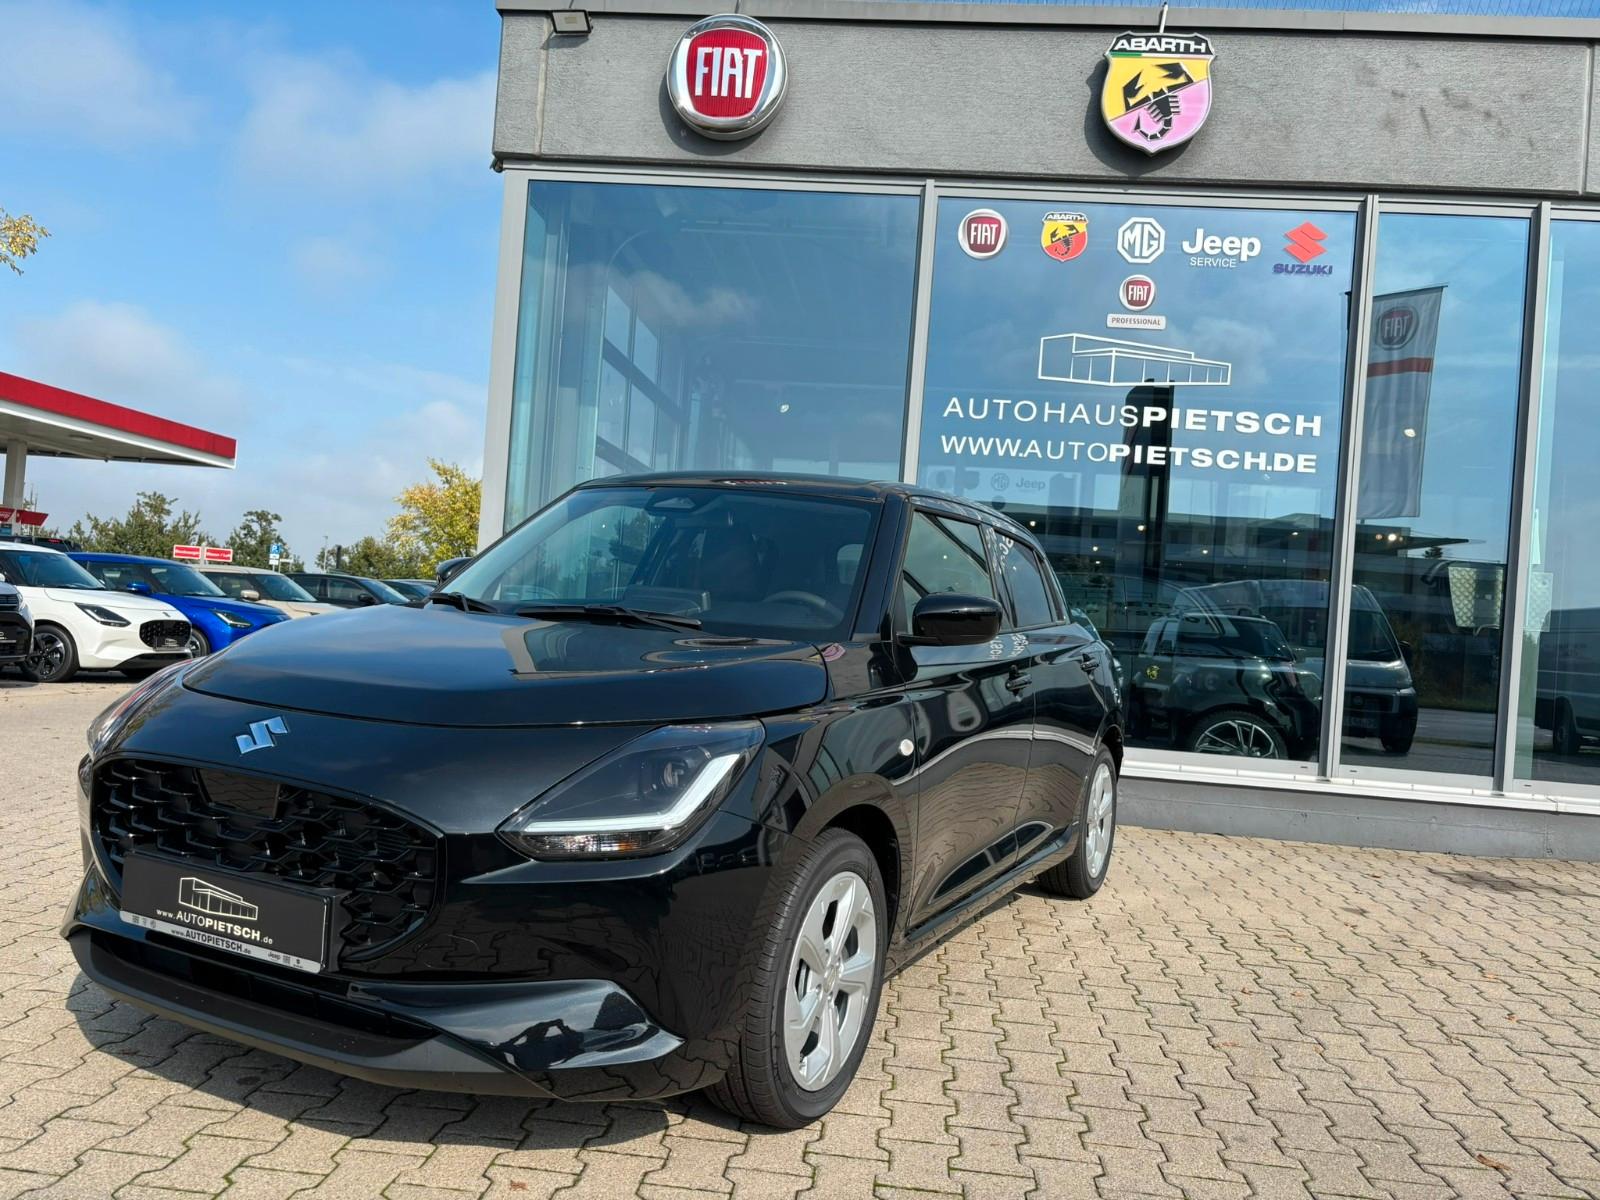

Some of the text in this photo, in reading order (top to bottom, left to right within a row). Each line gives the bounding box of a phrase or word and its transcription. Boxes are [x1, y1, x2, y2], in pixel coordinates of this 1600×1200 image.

[1113, 37, 1206, 53] ABARTH
[695, 46, 763, 99] FIAT
[1046, 213, 1087, 222] ABARTH
[970, 223, 999, 246] FIAT
[1123, 223, 1159, 257] MG
[1182, 227, 1262, 262] Jeep
[1189, 256, 1238, 268] SERVICE
[1272, 262, 1333, 275] SUZUKI
[1127, 284, 1150, 302] FIAT
[1111, 316, 1162, 327] PROFESSIONAL
[1384, 315, 1409, 339] FIAT
[941, 434, 1318, 474] WWW.AUTOPIETSCH.DE
[155, 908, 273, 945] www.AUTOPIETSCH.de
[170, 929, 252, 955] www.AUTOPIETSCH.de
